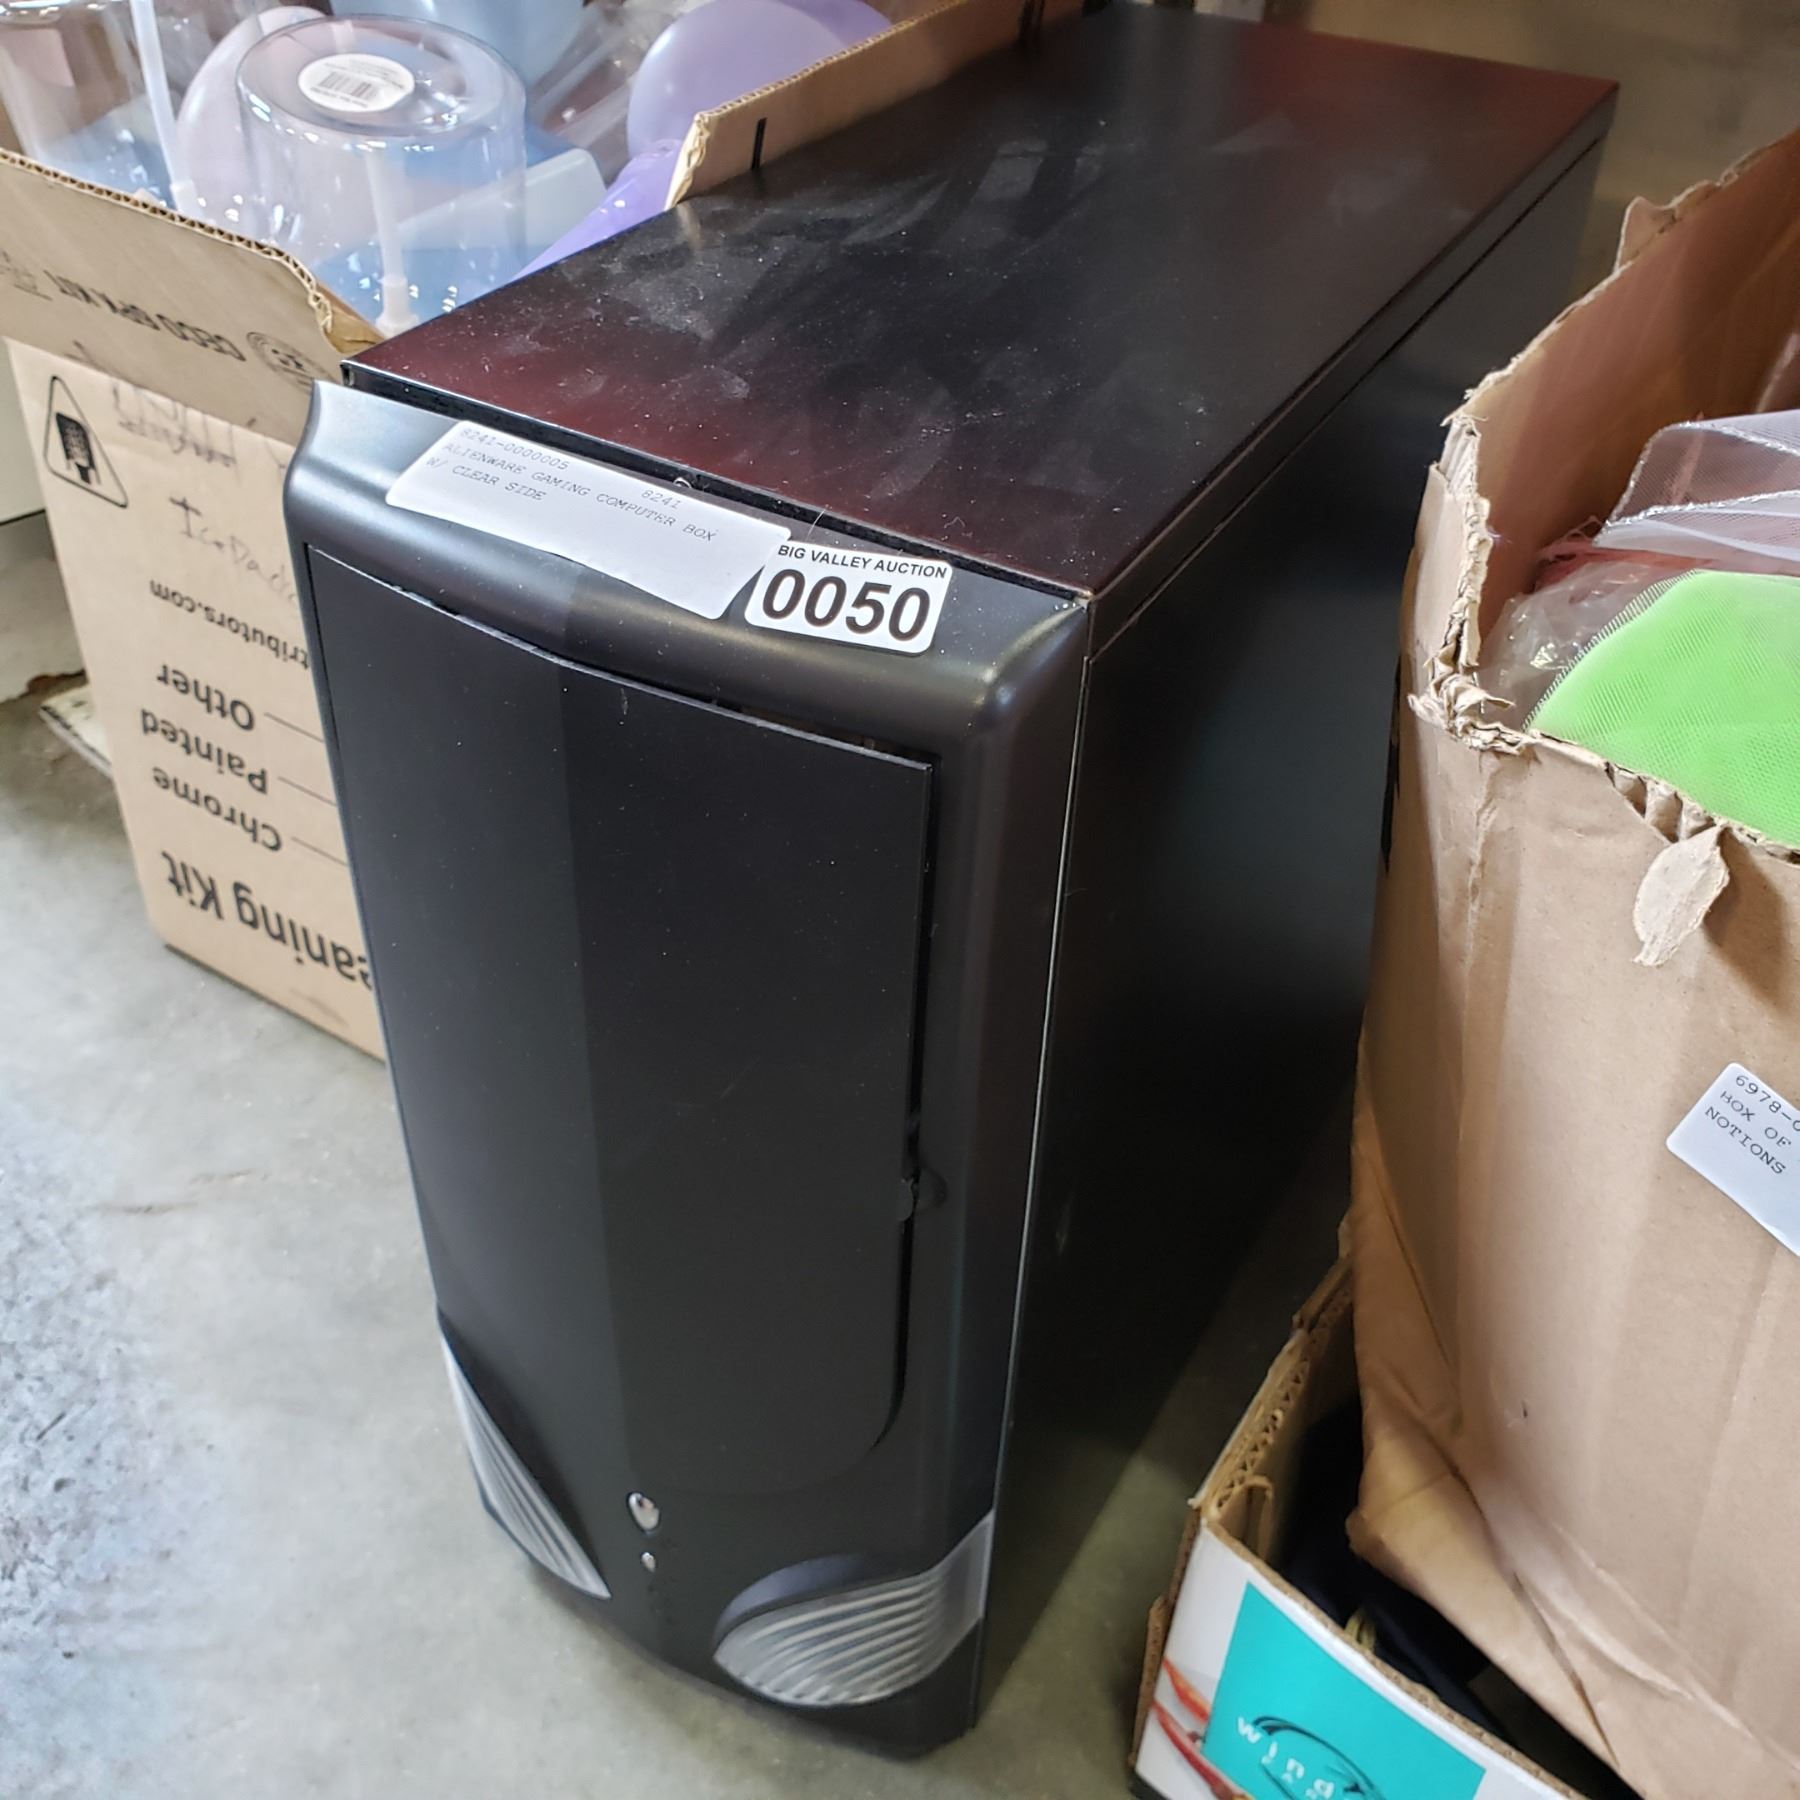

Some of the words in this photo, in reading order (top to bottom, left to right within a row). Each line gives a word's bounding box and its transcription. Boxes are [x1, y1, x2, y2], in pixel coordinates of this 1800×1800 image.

[442, 443, 526, 475] ALIENWARE
[531, 471, 591, 496] GAMING
[596, 493, 676, 526] COMPUTER
[683, 523, 717, 541] BOX
[452, 465, 500, 486] CLEAR
[505, 482, 547, 501] SIDE
[641, 489, 681, 509] 8241
[778, 544, 806, 559] BIG
[811, 549, 872, 570] VALLEY
[874, 559, 947, 579] AUCTION
[762, 568, 931, 642] 0050
[156, 663, 255, 731] Other
[141, 708, 269, 795] Painted
[153, 766, 283, 853] Chrome
[161, 850, 225, 921] Kit
[1705, 1106, 1787, 1174] NOTIONS
[1764, 1126, 1792, 1148] OF
